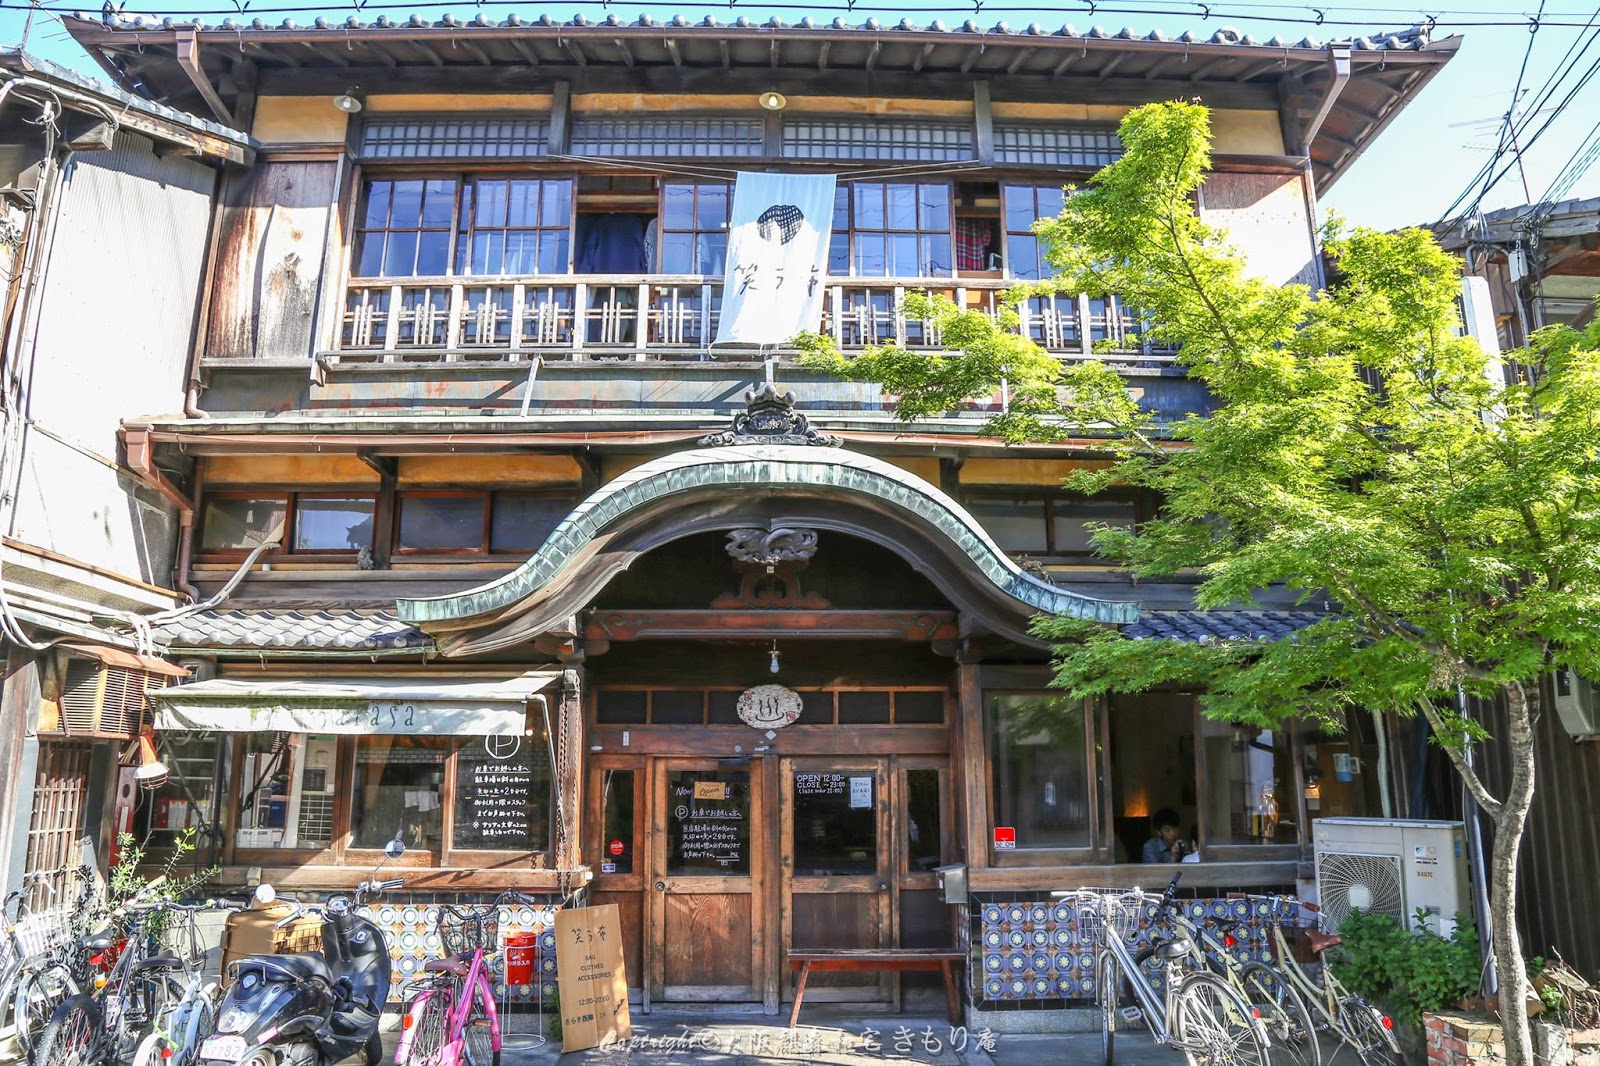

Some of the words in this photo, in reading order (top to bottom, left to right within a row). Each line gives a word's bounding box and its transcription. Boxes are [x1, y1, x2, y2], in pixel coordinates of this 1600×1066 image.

[796, 774, 821, 782] OPEN
[676, 787, 693, 796] Now
[699, 787, 720, 797] Open
[580, 962, 604, 972] CLOTHES
[577, 971, 612, 982] ACCESSORIES
